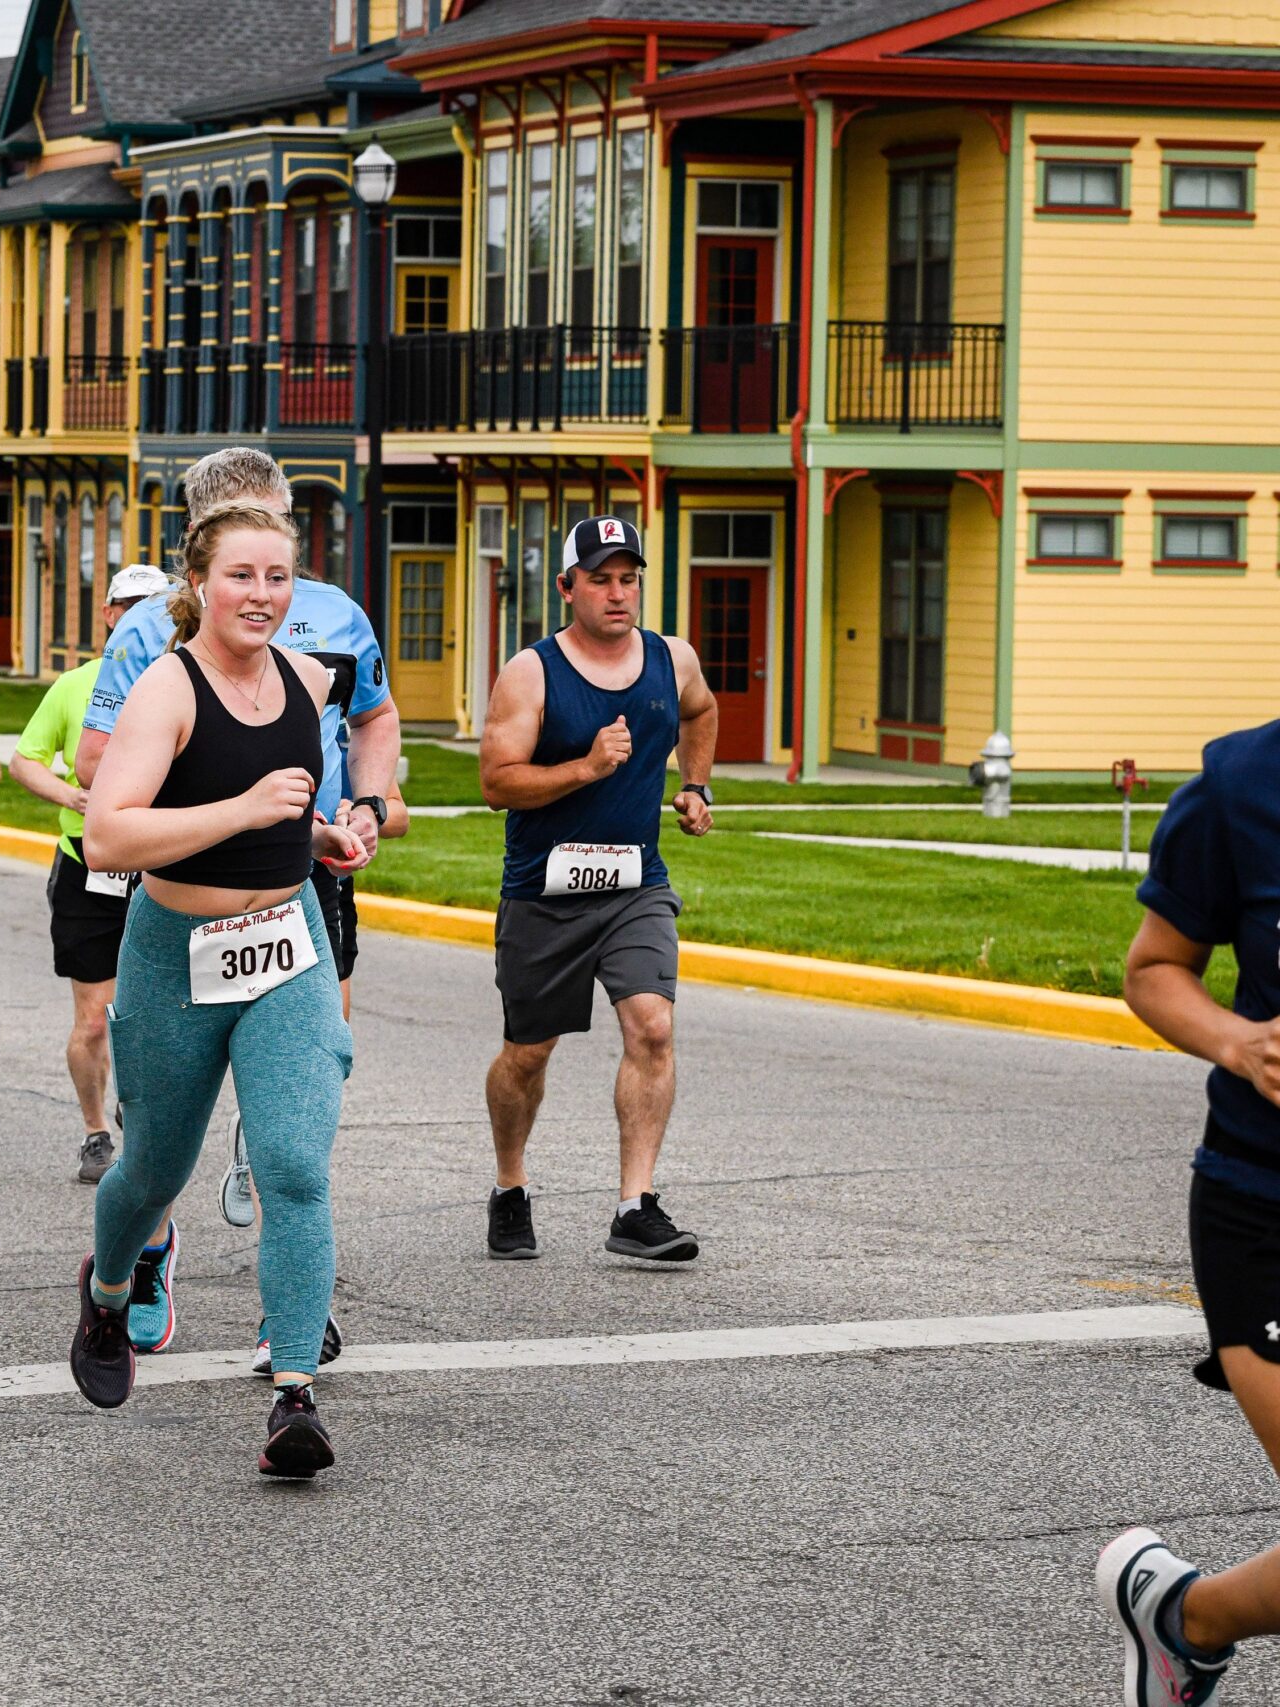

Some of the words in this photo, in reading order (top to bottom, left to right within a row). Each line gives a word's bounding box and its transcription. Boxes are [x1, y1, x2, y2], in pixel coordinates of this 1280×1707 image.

[568, 867, 620, 890] 3084
[202, 920, 225, 936] Bald
[226, 916, 252, 932] Eagle
[252, 904, 295, 926] Multisports
[221, 938, 294, 980] 3070
